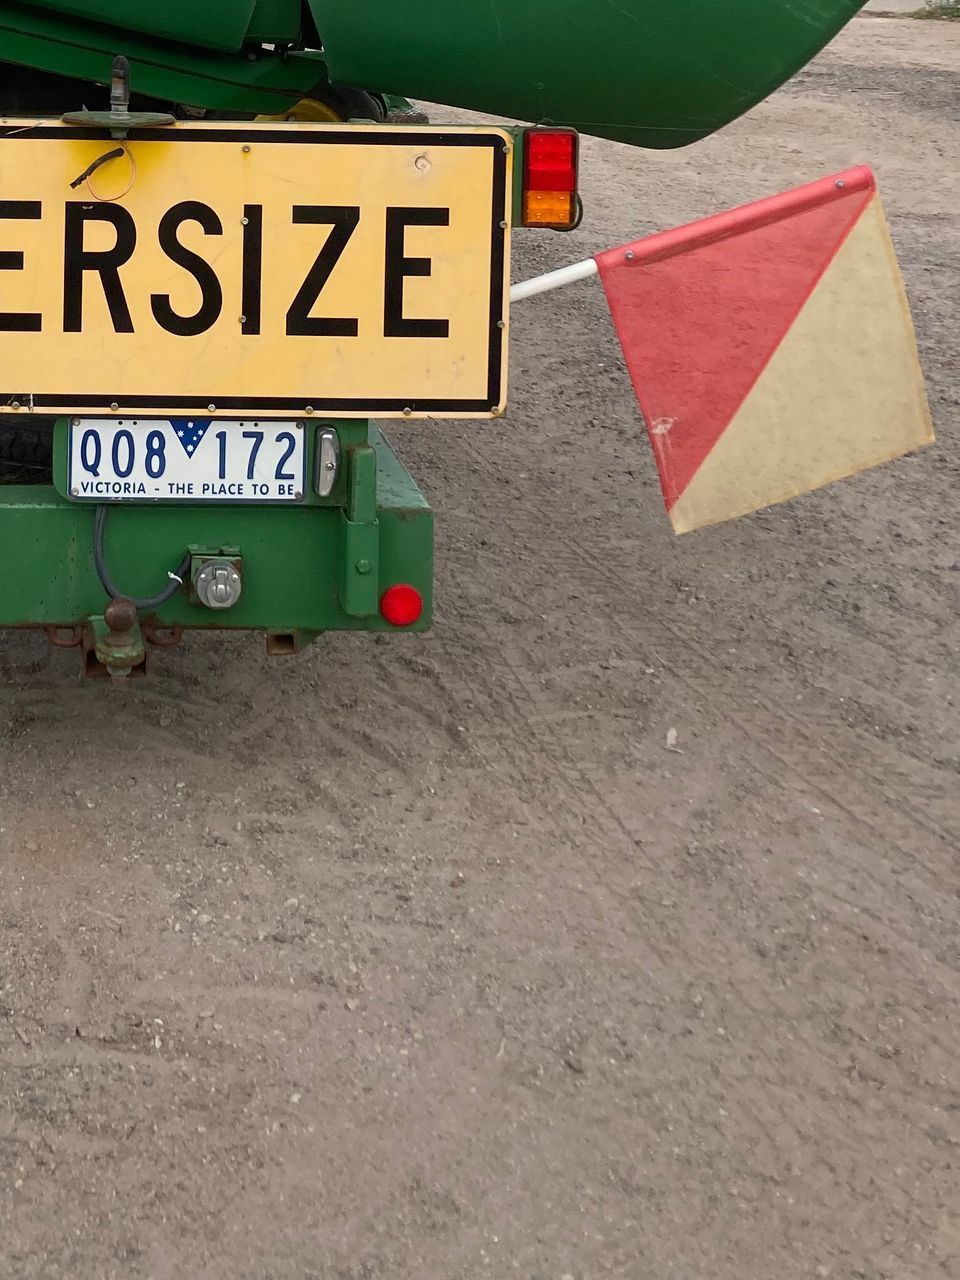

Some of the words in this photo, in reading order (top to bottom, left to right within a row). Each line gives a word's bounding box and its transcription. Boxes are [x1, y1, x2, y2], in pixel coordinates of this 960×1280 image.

[80, 428, 167, 479] Q08
[215, 430, 297, 480] 172
[80, 481, 146, 495] VICTORIA
[168, 482, 194, 495] THE
[202, 483, 244, 495] PLACE
[251, 483, 270, 496] TO
[278, 483, 295, 496] BE
